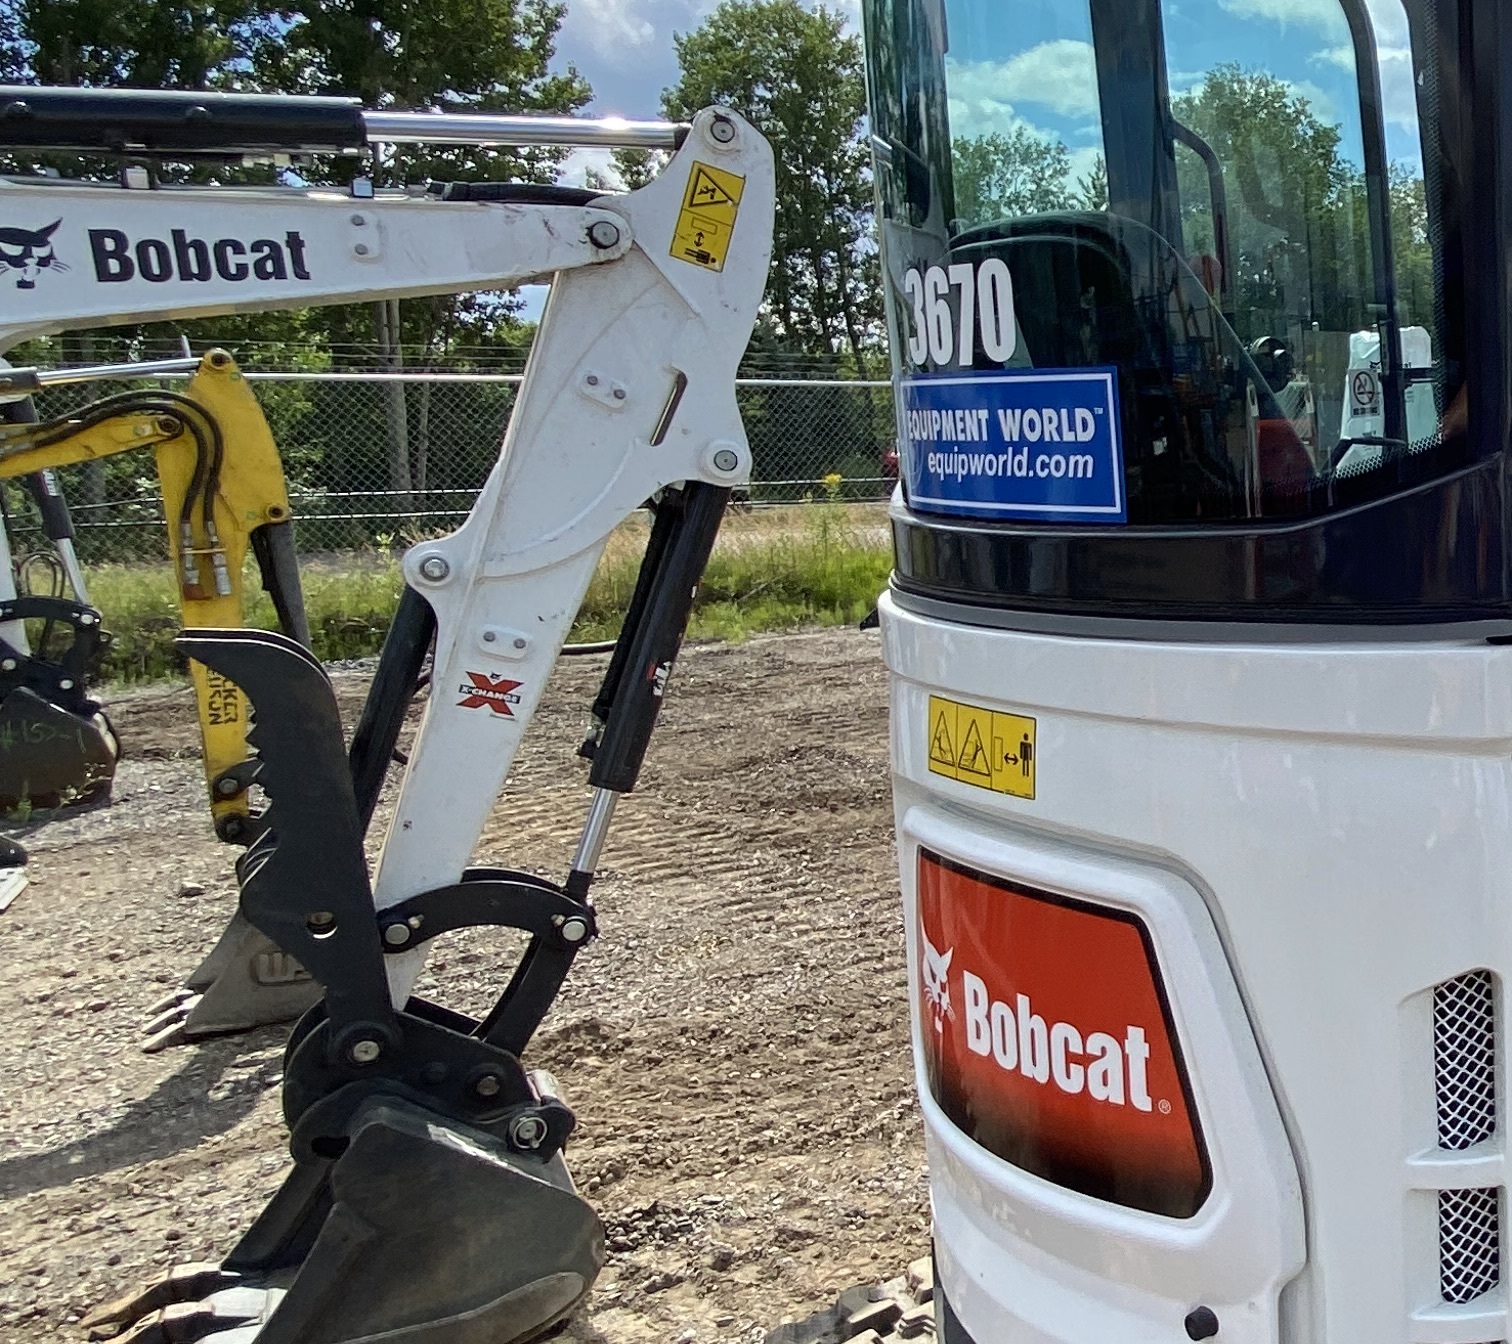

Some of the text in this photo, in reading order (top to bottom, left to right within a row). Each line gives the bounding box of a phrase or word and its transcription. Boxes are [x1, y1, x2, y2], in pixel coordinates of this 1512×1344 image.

[88, 229, 311, 282] Bobcat
[905, 258, 1016, 366] 3670
[906, 408, 989, 442] EQUIPMENT
[928, 445, 1094, 482] equipworld.com
